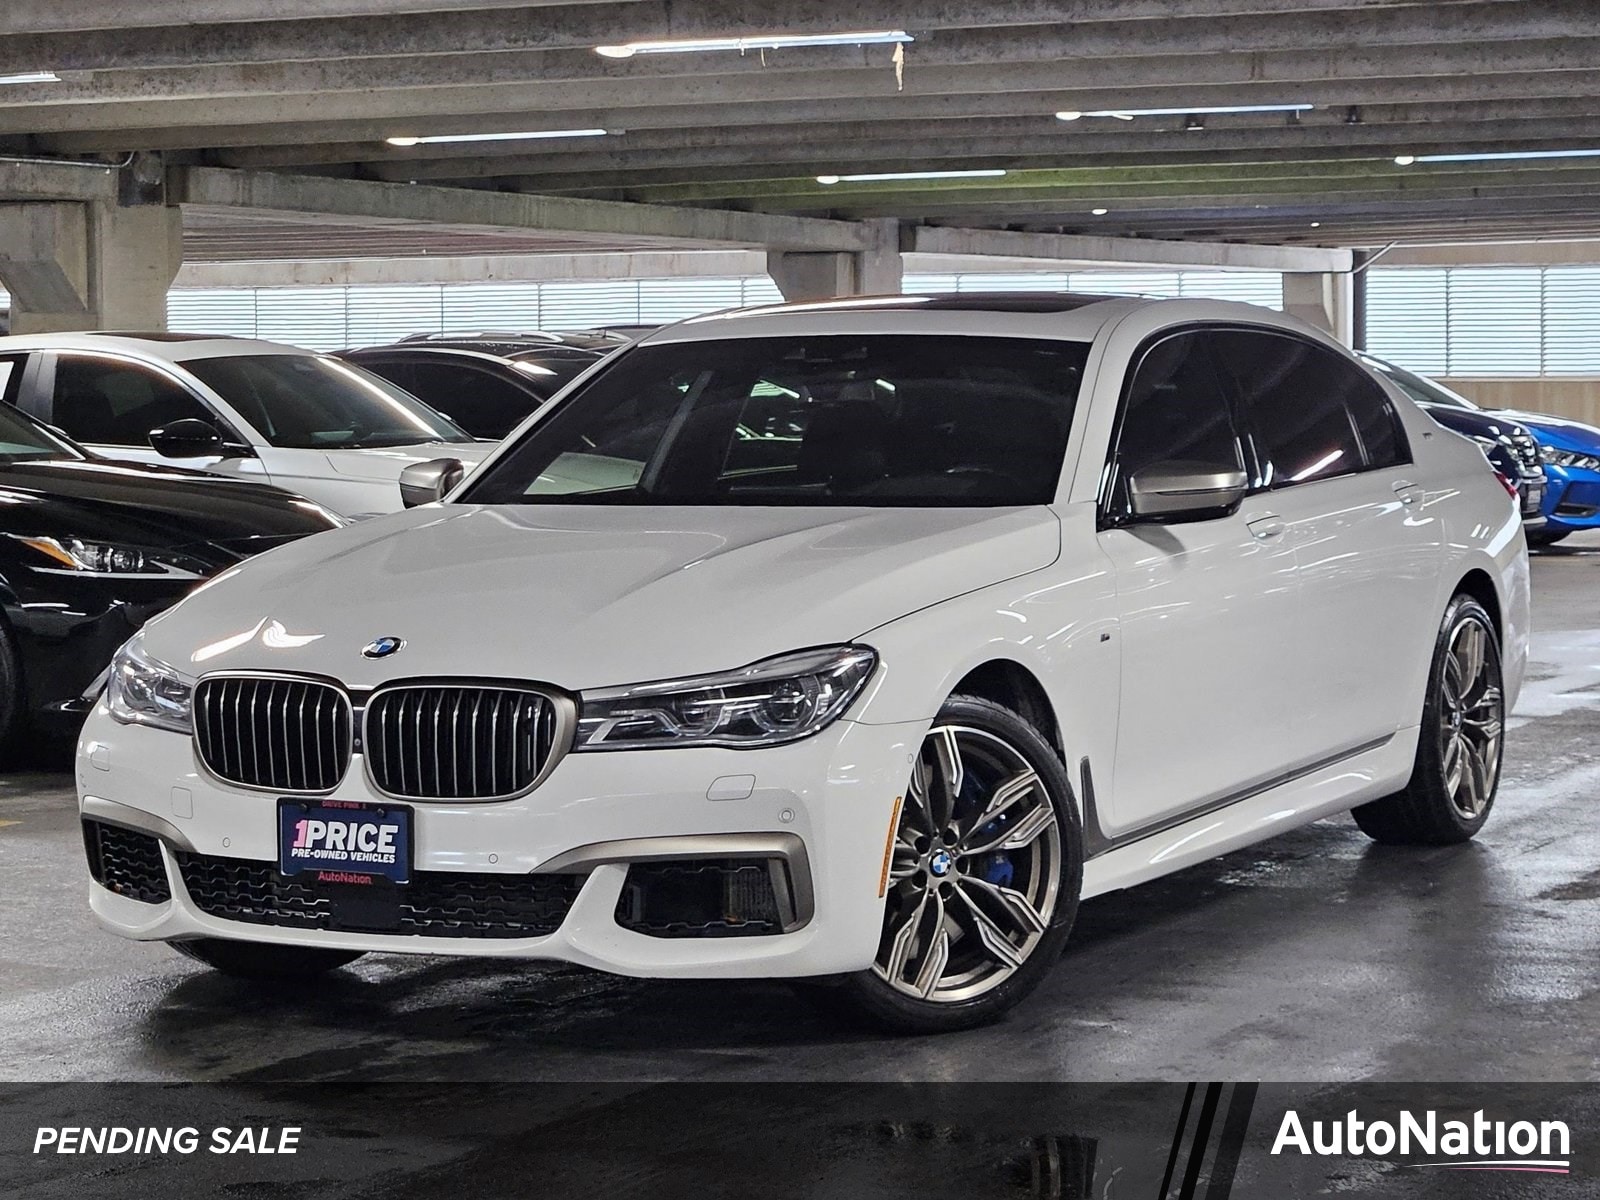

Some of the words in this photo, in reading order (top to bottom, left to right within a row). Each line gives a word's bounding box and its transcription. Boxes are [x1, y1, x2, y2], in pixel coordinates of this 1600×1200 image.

[291, 848, 348, 860] PRE-OWNED
[350, 852, 396, 863] VEHICLES
[318, 871, 372, 884] AutoNation
